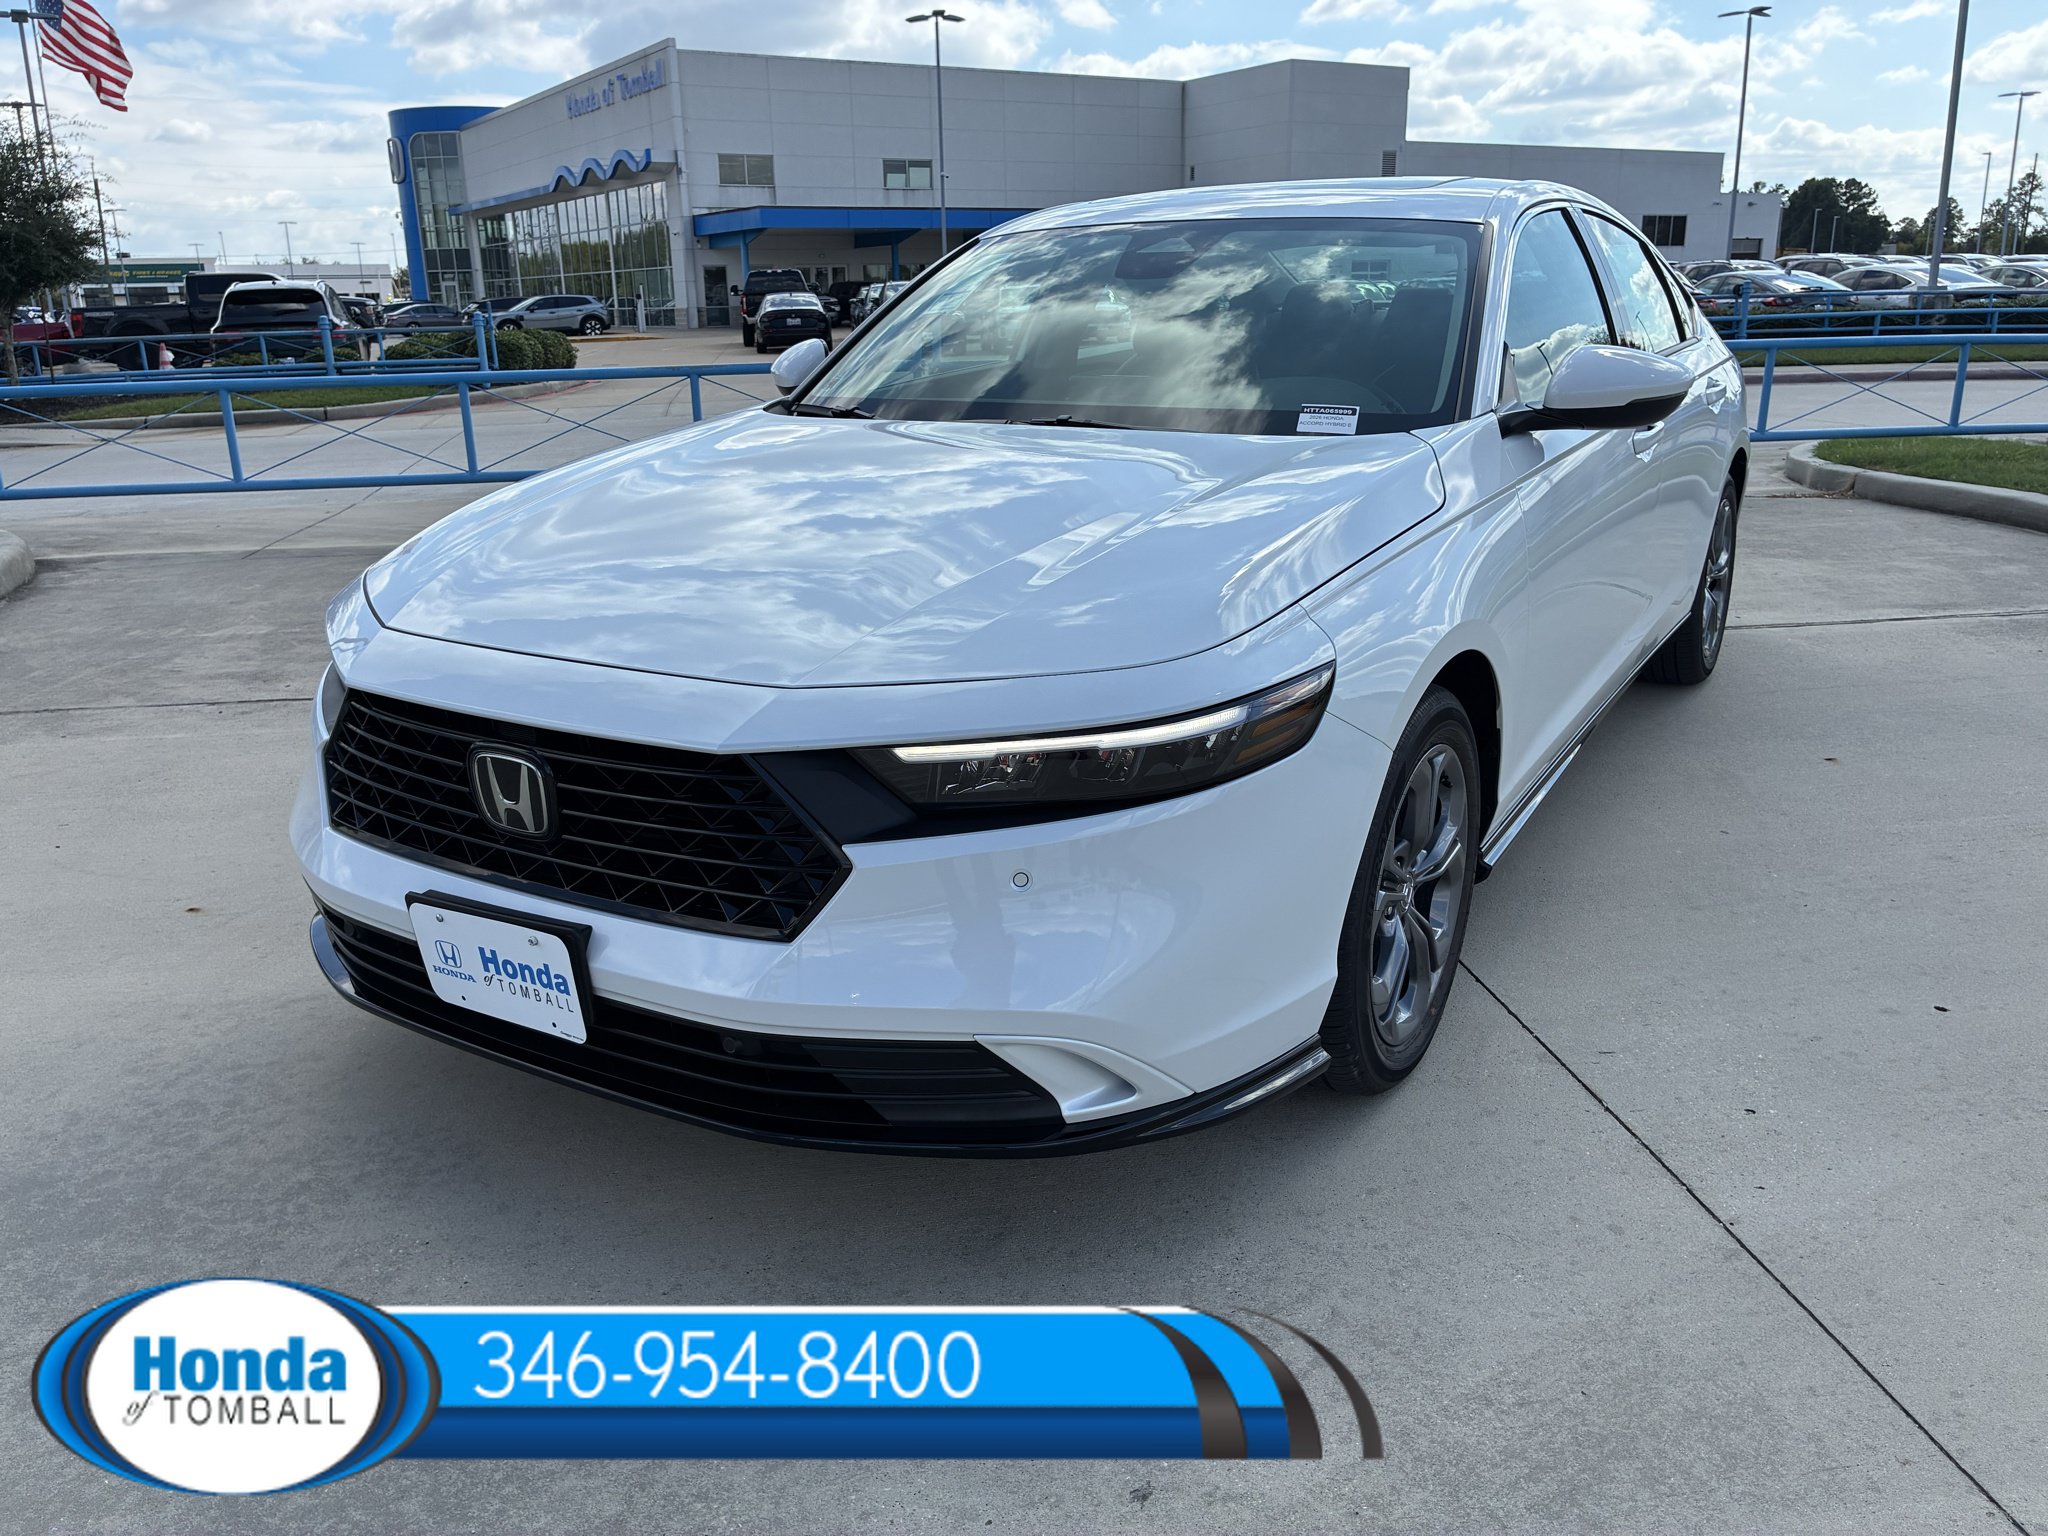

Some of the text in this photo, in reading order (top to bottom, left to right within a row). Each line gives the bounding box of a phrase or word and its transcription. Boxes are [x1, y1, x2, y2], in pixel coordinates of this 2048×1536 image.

[602, 79, 615, 107] of
[432, 964, 477, 984] HONDA
[478, 946, 571, 996] Honda
[483, 973, 575, 1013] of TOMBALL
